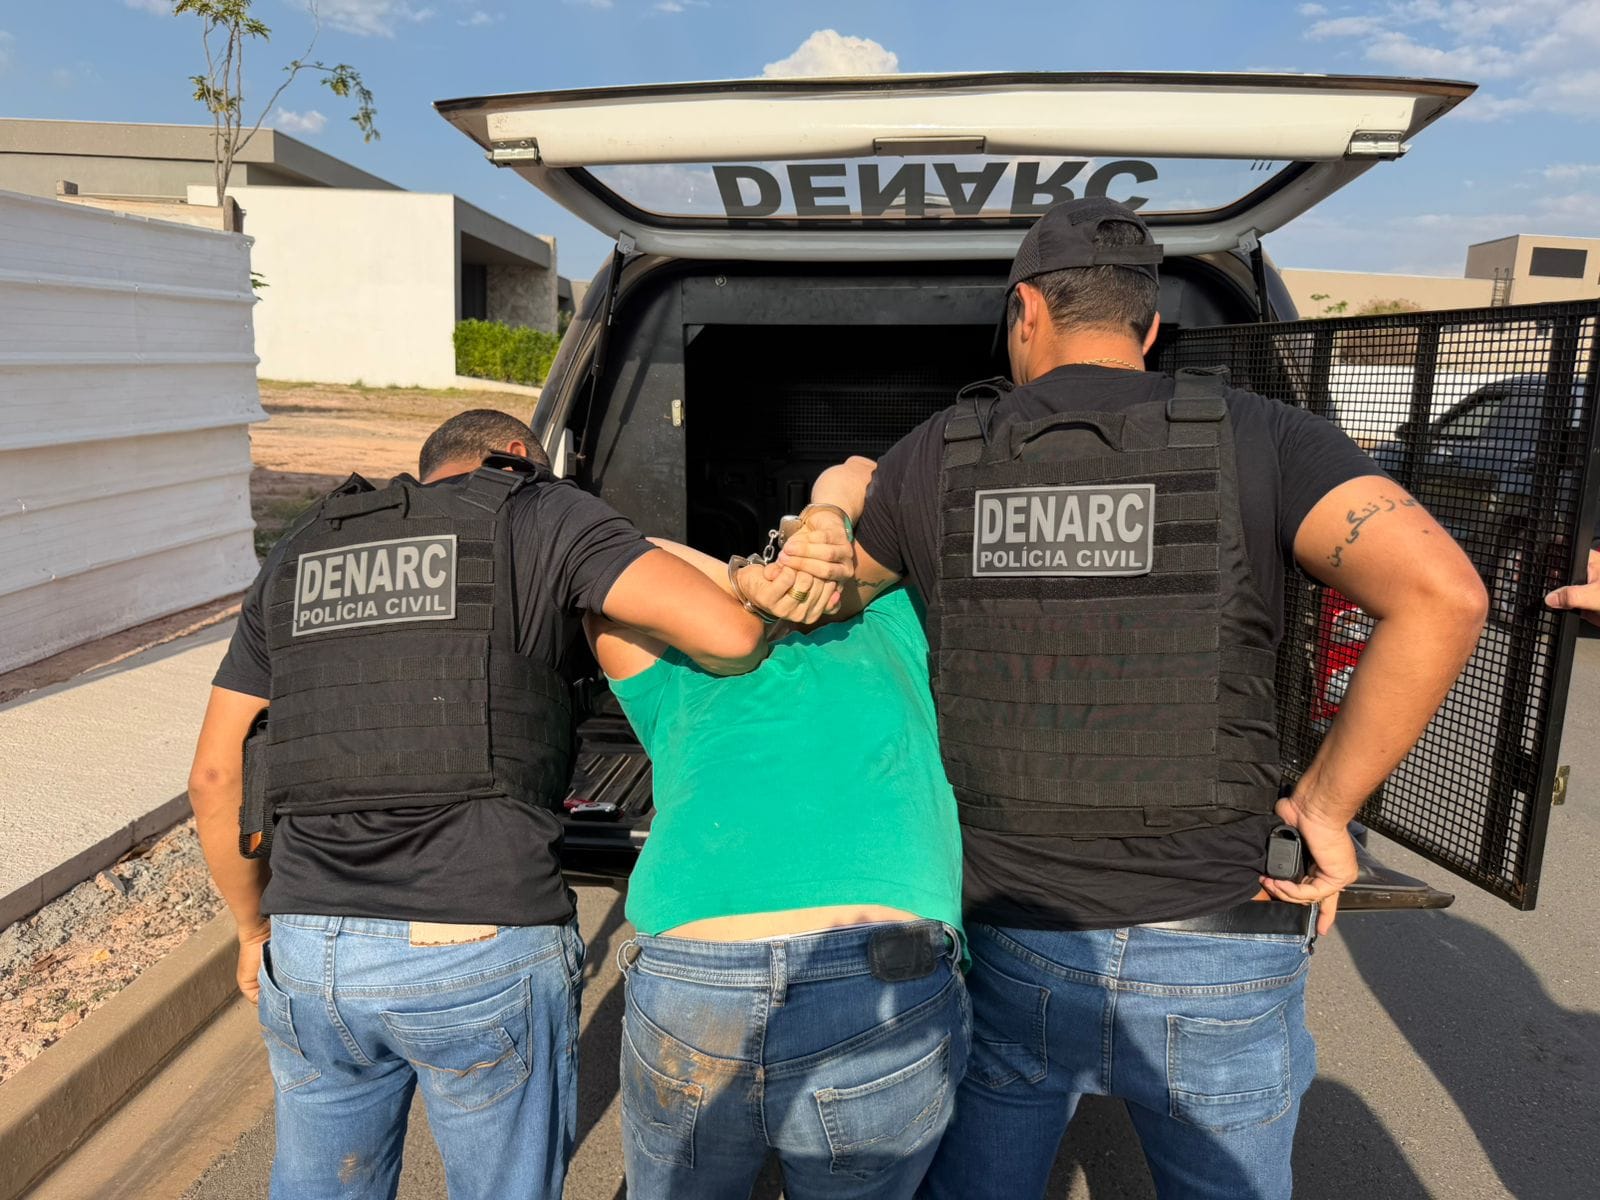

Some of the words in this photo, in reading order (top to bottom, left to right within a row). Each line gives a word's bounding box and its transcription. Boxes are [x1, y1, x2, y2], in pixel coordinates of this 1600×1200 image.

[981, 493, 1144, 544] DENARC
[301, 543, 447, 605] DENARC
[980, 546, 1068, 568] POLÍCIA
[1076, 550, 1142, 567] CIVIL
[300, 601, 378, 627] POLÍCIA
[385, 595, 446, 615] CIVIL
